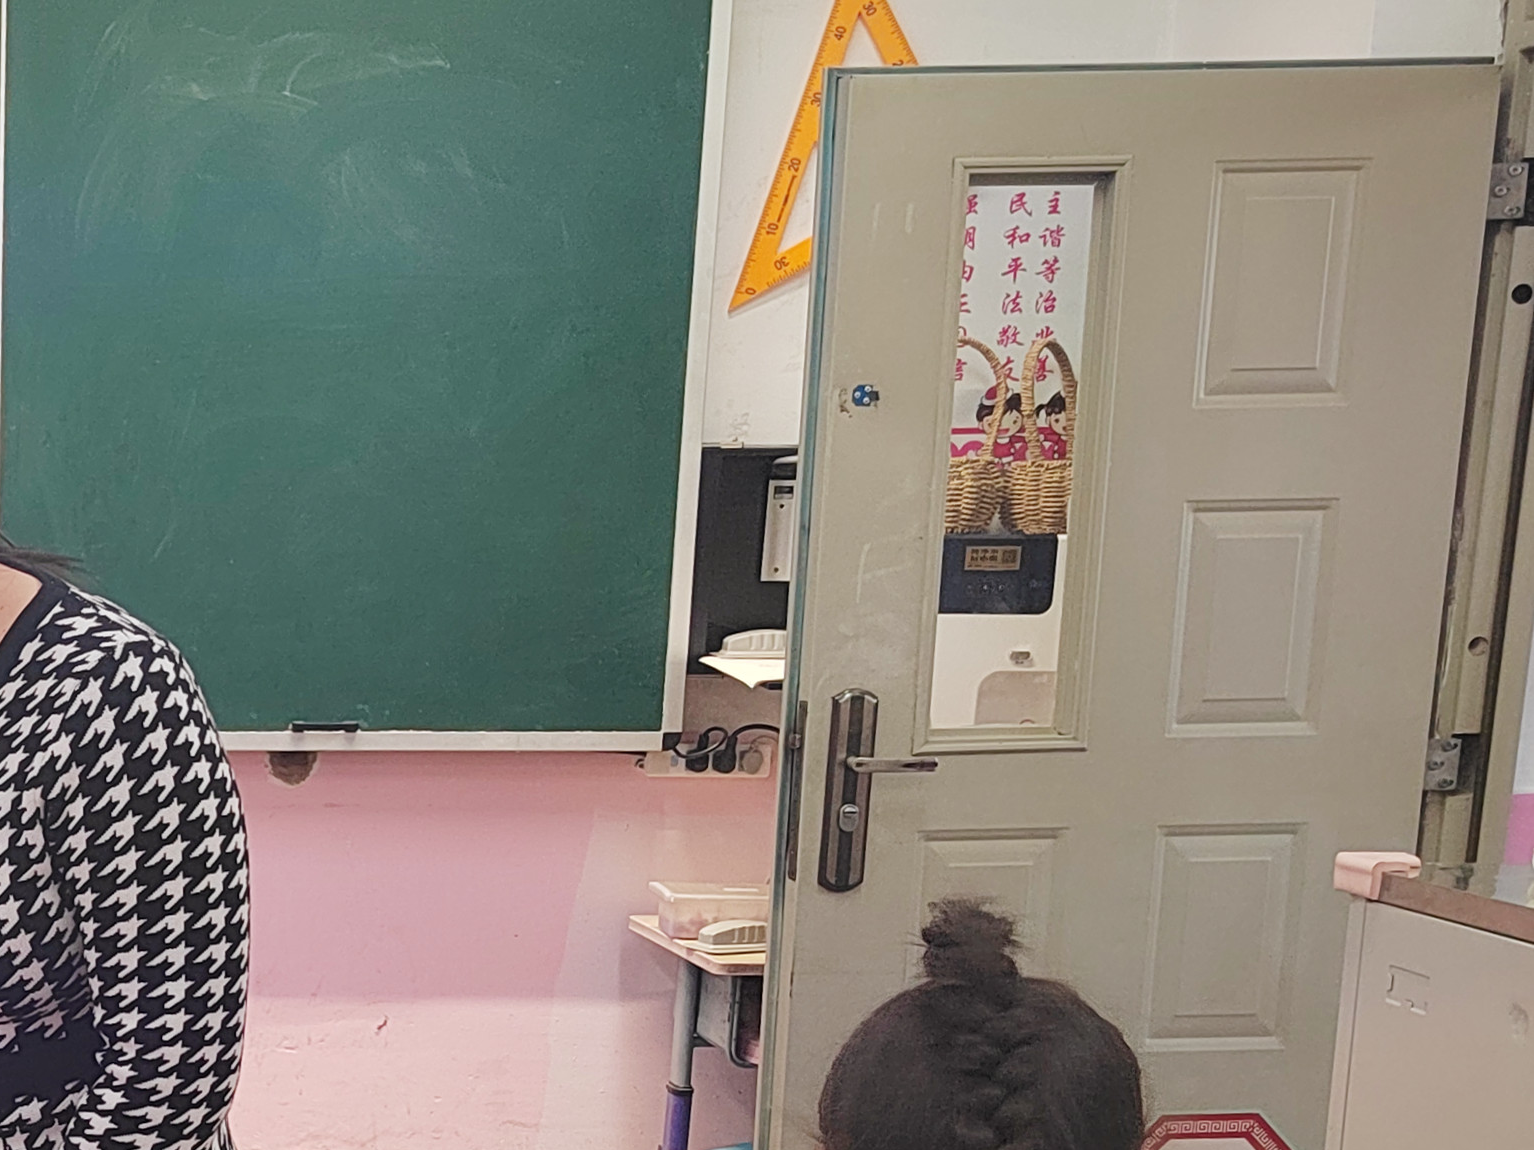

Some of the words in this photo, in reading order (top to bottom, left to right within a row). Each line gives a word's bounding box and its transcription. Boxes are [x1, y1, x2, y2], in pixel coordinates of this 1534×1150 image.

[862, 1, 878, 17] 30
[833, 25, 847, 42] 40
[787, 157, 802, 173] 20
[1009, 190, 1061, 217] 民主
[766, 222, 779, 236] 10
[1003, 224, 1066, 249] 和谐
[774, 256, 790, 271] 30
[1001, 255, 1062, 284] 平等
[1001, 289, 1057, 315] 法治
